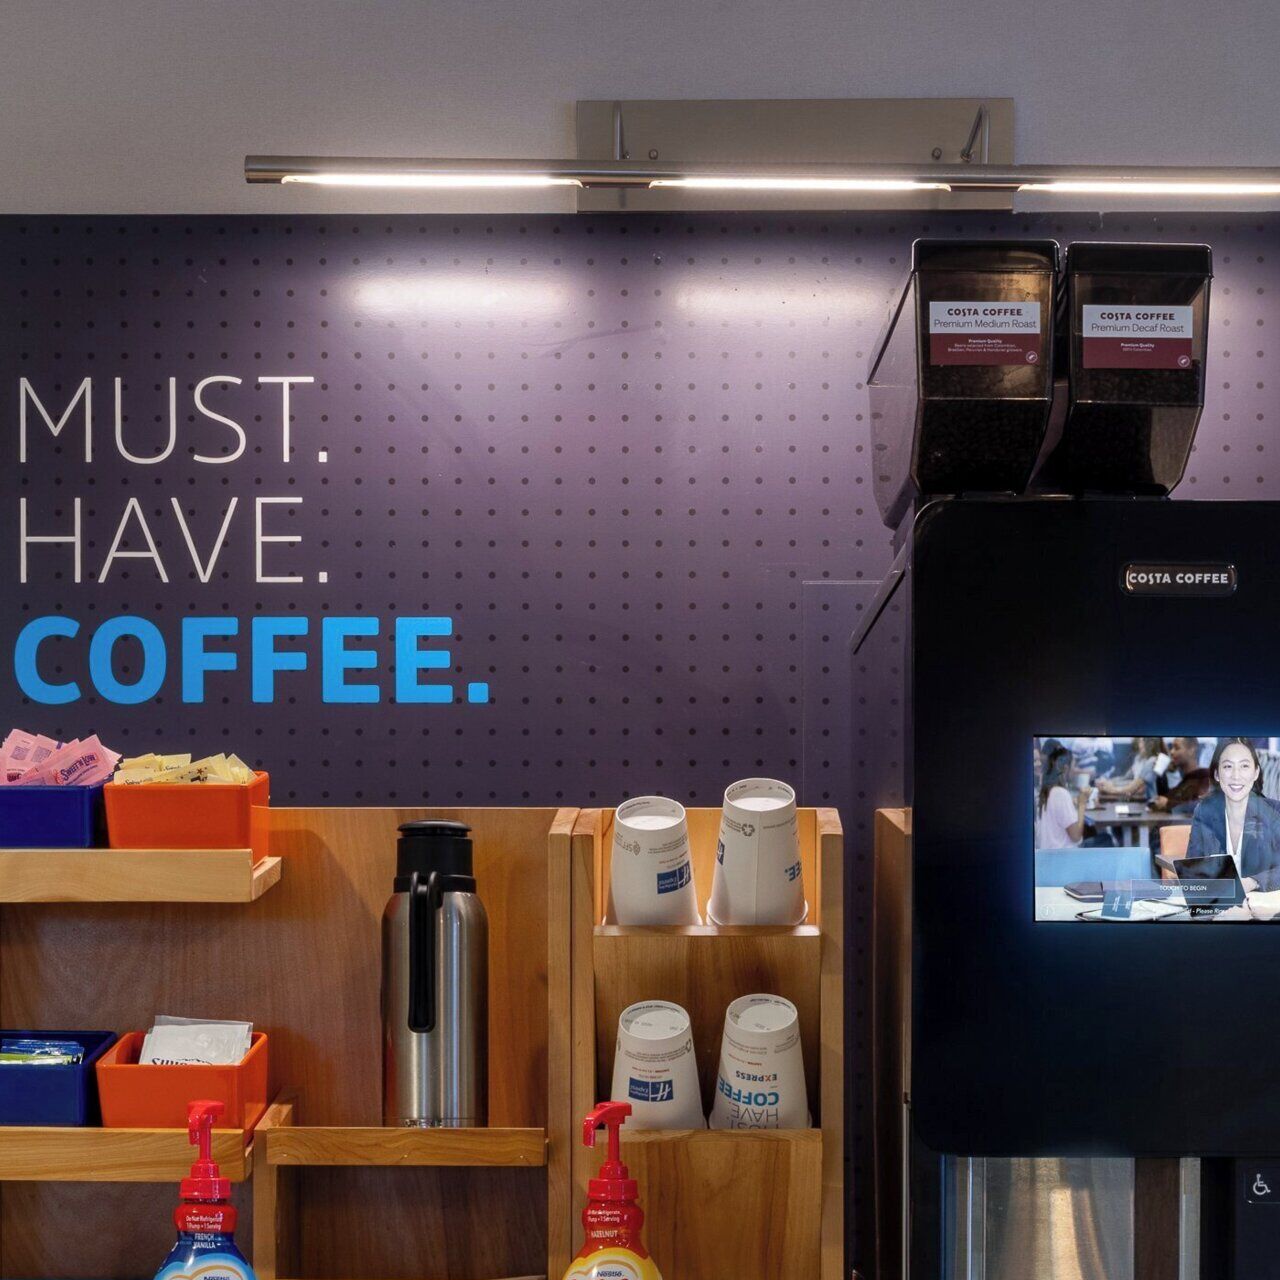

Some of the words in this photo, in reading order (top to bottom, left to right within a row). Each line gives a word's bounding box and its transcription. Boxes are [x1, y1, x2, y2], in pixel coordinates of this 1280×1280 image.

[947, 308, 979, 317] COSTA
[983, 308, 1023, 316] COFFEE
[1100, 312, 1132, 321] COSTA
[1135, 312, 1175, 320] COFFEE
[934, 319, 973, 328] Premium
[975, 319, 1010, 328] Medium
[1012, 320, 1037, 328] Roast
[1091, 323, 1130, 332] Premium
[1132, 324, 1158, 332] Decaf
[1160, 324, 1185, 333] Roast
[18, 375, 329, 465] MUST.
[19, 496, 329, 584] HAVE.
[1129, 573, 1172, 584] COSTA
[1176, 573, 1229, 584] COFFEE
[13, 615, 490, 706] COFFEE.
[736, 1070, 778, 1082] EXPRESS
[728, 1102, 779, 1122] HAVE.
